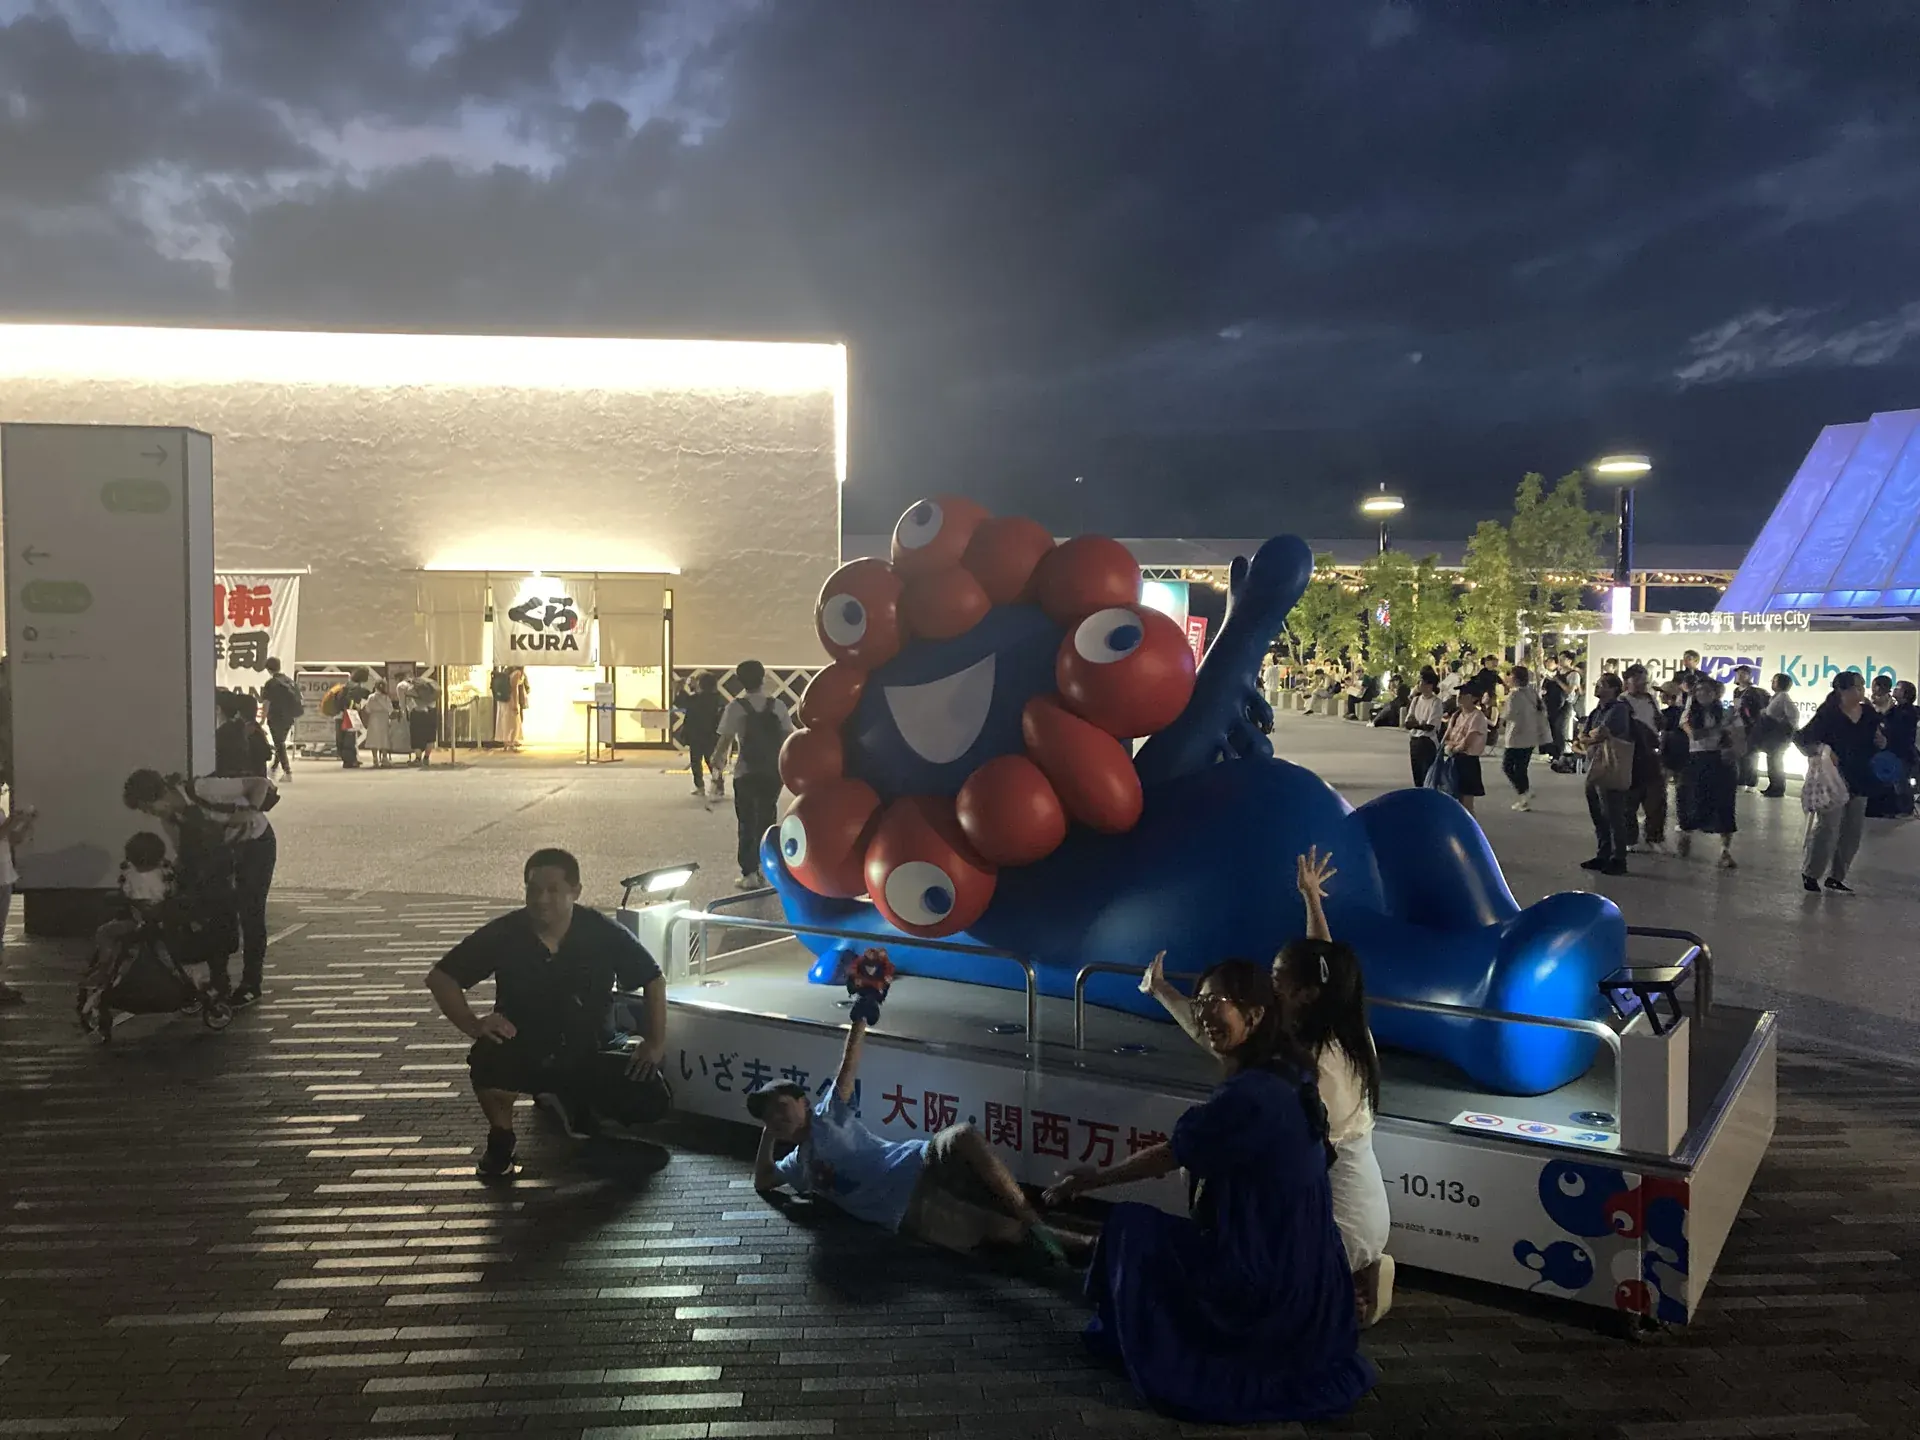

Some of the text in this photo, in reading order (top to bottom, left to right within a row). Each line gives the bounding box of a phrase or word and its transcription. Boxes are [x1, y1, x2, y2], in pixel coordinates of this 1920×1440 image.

[214, 584, 272, 627] 転
[508, 597, 578, 631] くら
[1676, 610, 1811, 628] 未来の都市 Future City
[215, 631, 270, 672] 司
[510, 634, 579, 651] KURA
[1703, 643, 1766, 652] Tomorrow Together
[1701, 657, 1763, 686] KDDI
